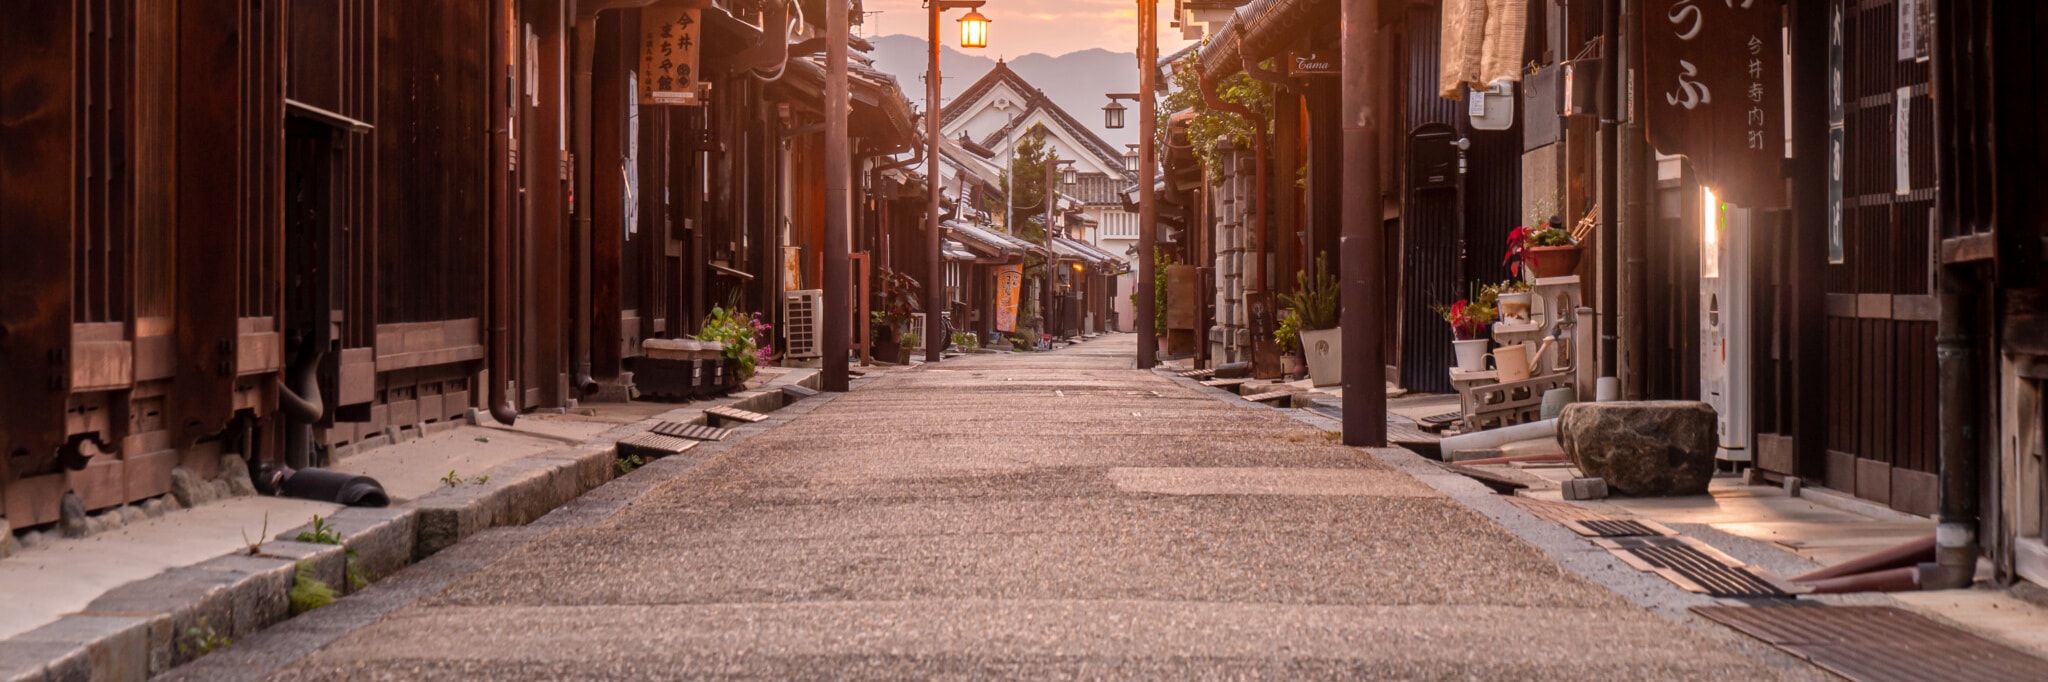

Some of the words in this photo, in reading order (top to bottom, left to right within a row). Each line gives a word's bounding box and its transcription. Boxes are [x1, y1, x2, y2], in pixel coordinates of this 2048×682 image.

[658, 22, 673, 92] まちや館
[677, 12, 695, 51] 今井
[1296, 53, 1329, 70] Tama
[1747, 34, 1764, 150] 今井寺内町
